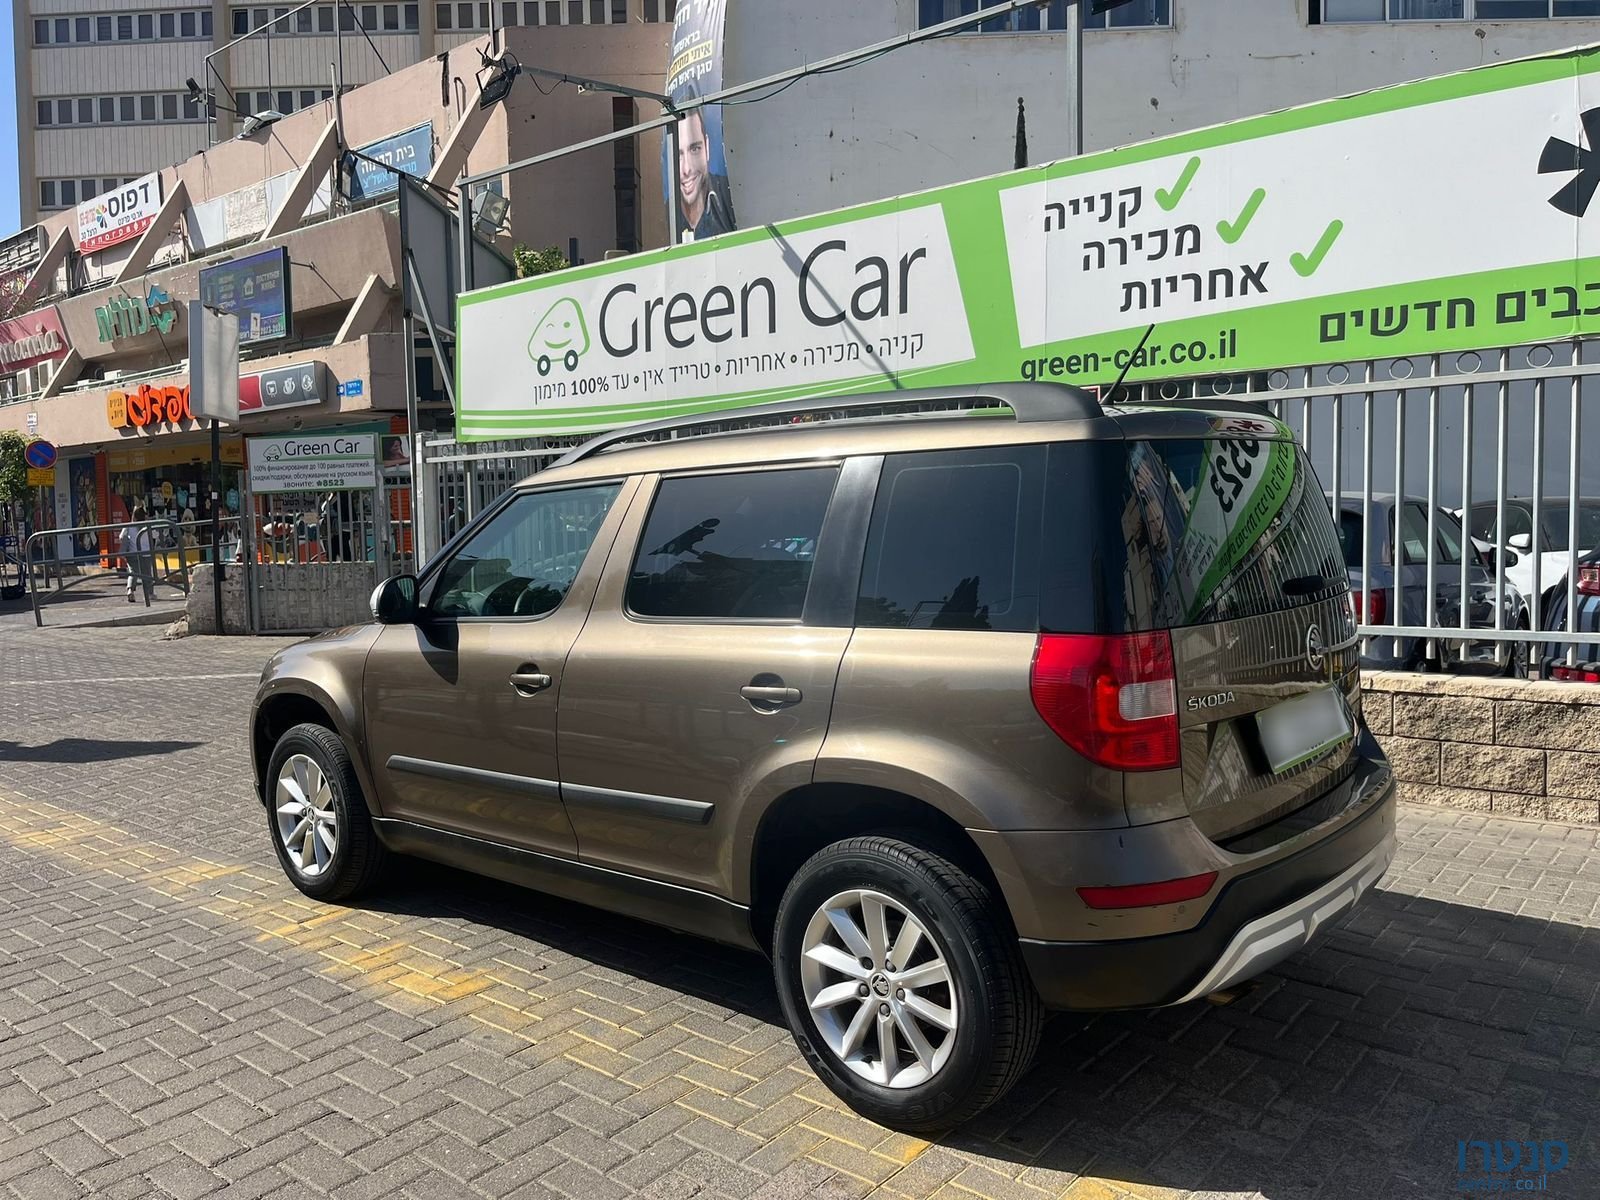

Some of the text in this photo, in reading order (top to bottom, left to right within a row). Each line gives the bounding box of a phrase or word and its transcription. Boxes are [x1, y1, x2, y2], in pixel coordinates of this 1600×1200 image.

[679, 67, 694, 85] ראש
[697, 60, 712, 80] סגן
[396, 145, 415, 162] בית
[108, 183, 149, 217] דפוס
[1044, 185, 1142, 232] קנייה
[1083, 223, 1201, 271] מכירה
[599, 239, 927, 358] Green Car
[1120, 261, 1270, 313] אחריות
[1319, 297, 1475, 343] חדשים
[534, 333, 924, 405] קניה מכירה אחריות טרייד אין עד 100% מימון
[1021, 328, 1236, 381] green-car.co.il
[284, 439, 360, 456] Green Car
[253, 464, 266, 472] 100%
[327, 462, 345, 470] равных
[293, 472, 329, 480] обслуживание
[337, 471, 358, 479] русском
[1187, 691, 1235, 711] ŠKODA
